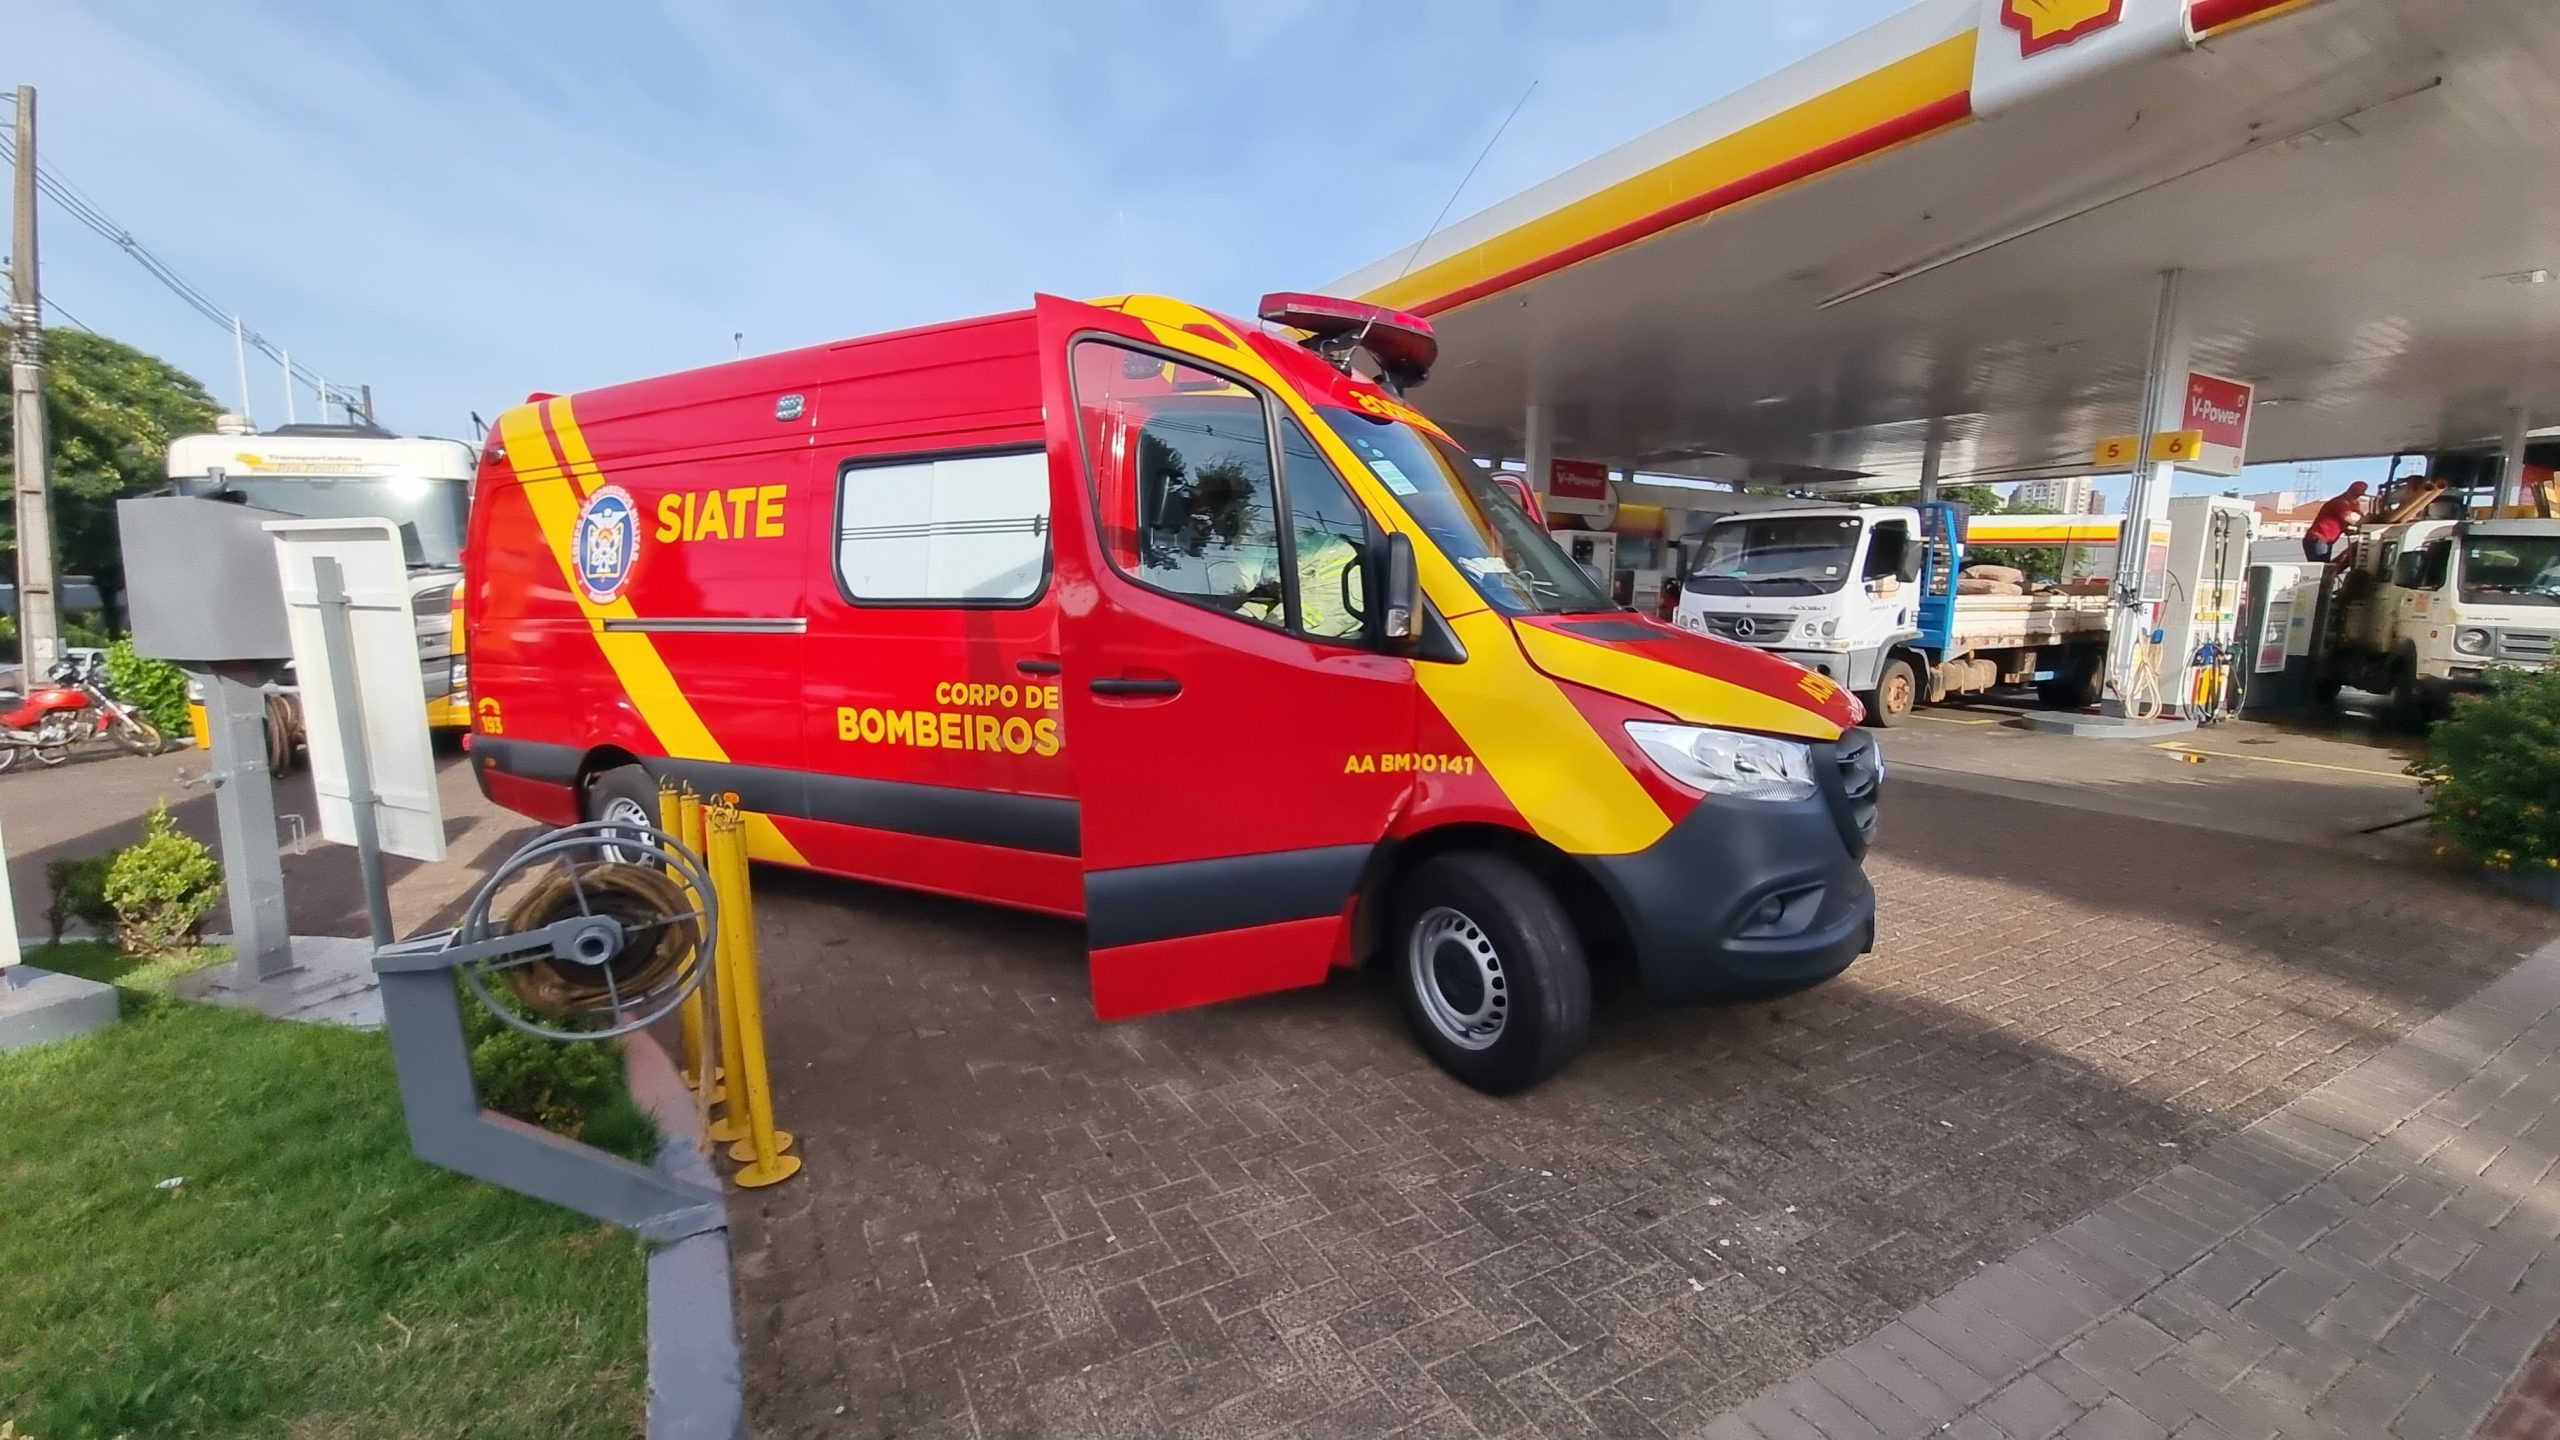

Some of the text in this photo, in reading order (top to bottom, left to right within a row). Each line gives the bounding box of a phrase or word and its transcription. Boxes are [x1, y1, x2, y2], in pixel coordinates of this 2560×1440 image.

[2192, 396, 2241, 426] V-Power
[2107, 437, 2183, 458] 5 6
[1556, 471, 1601, 488] V-Power
[655, 484, 787, 544] SIATE
[936, 681, 1059, 709] CORPO DE
[481, 715, 504, 734] 193
[837, 706, 1060, 757] BOMBEIROS
[1343, 754, 1376, 774] AA
